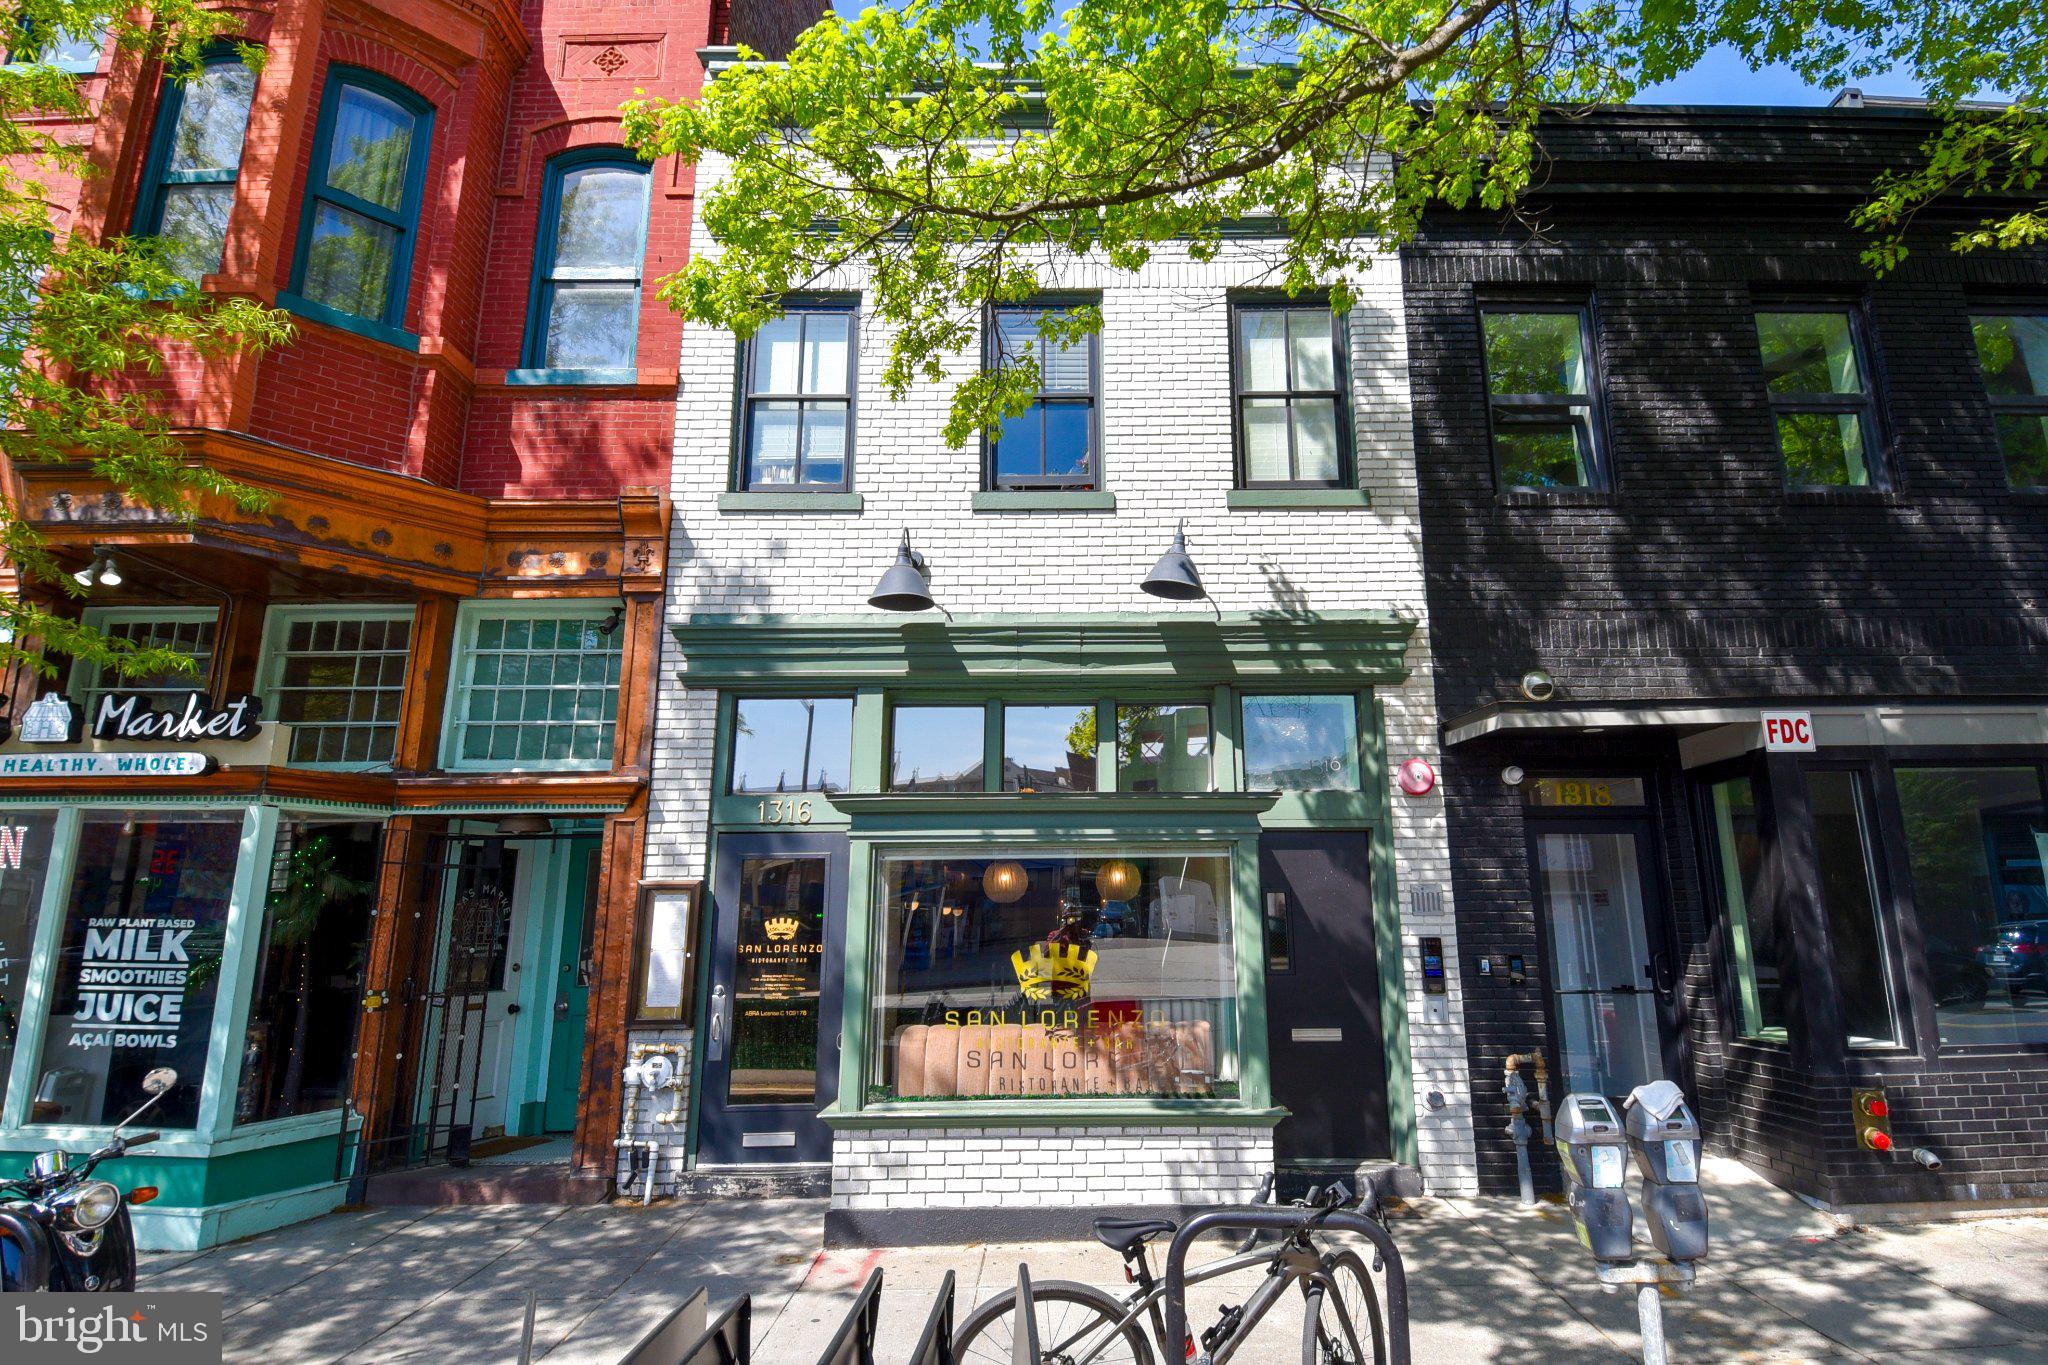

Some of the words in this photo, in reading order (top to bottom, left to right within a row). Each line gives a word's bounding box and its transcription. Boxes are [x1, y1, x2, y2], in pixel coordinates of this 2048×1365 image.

[94, 692, 248, 738] Market
[1766, 718, 1810, 744] FDC
[3, 757, 104, 772] HEALTHY.
[117, 756, 195, 771] WHOLE.
[1553, 782, 1613, 806] 1318
[757, 800, 812, 825] 1316
[88, 918, 116, 928] RAW
[118, 918, 157, 928] PLANT
[156, 918, 196, 928] BASED
[82, 928, 194, 962] MILK
[738, 944, 762, 954] SAN
[766, 944, 823, 953] LORENZO
[78, 968, 188, 985] SMOOTHIES
[73, 992, 184, 1022] JUICE
[945, 1010, 1006, 1031] SAN
[1021, 1009, 1165, 1031] LORENZO
[68, 1029, 113, 1050] AÇAÍ
[114, 1034, 178, 1049] BOWLS
[966, 1050, 1027, 1070] SAN
